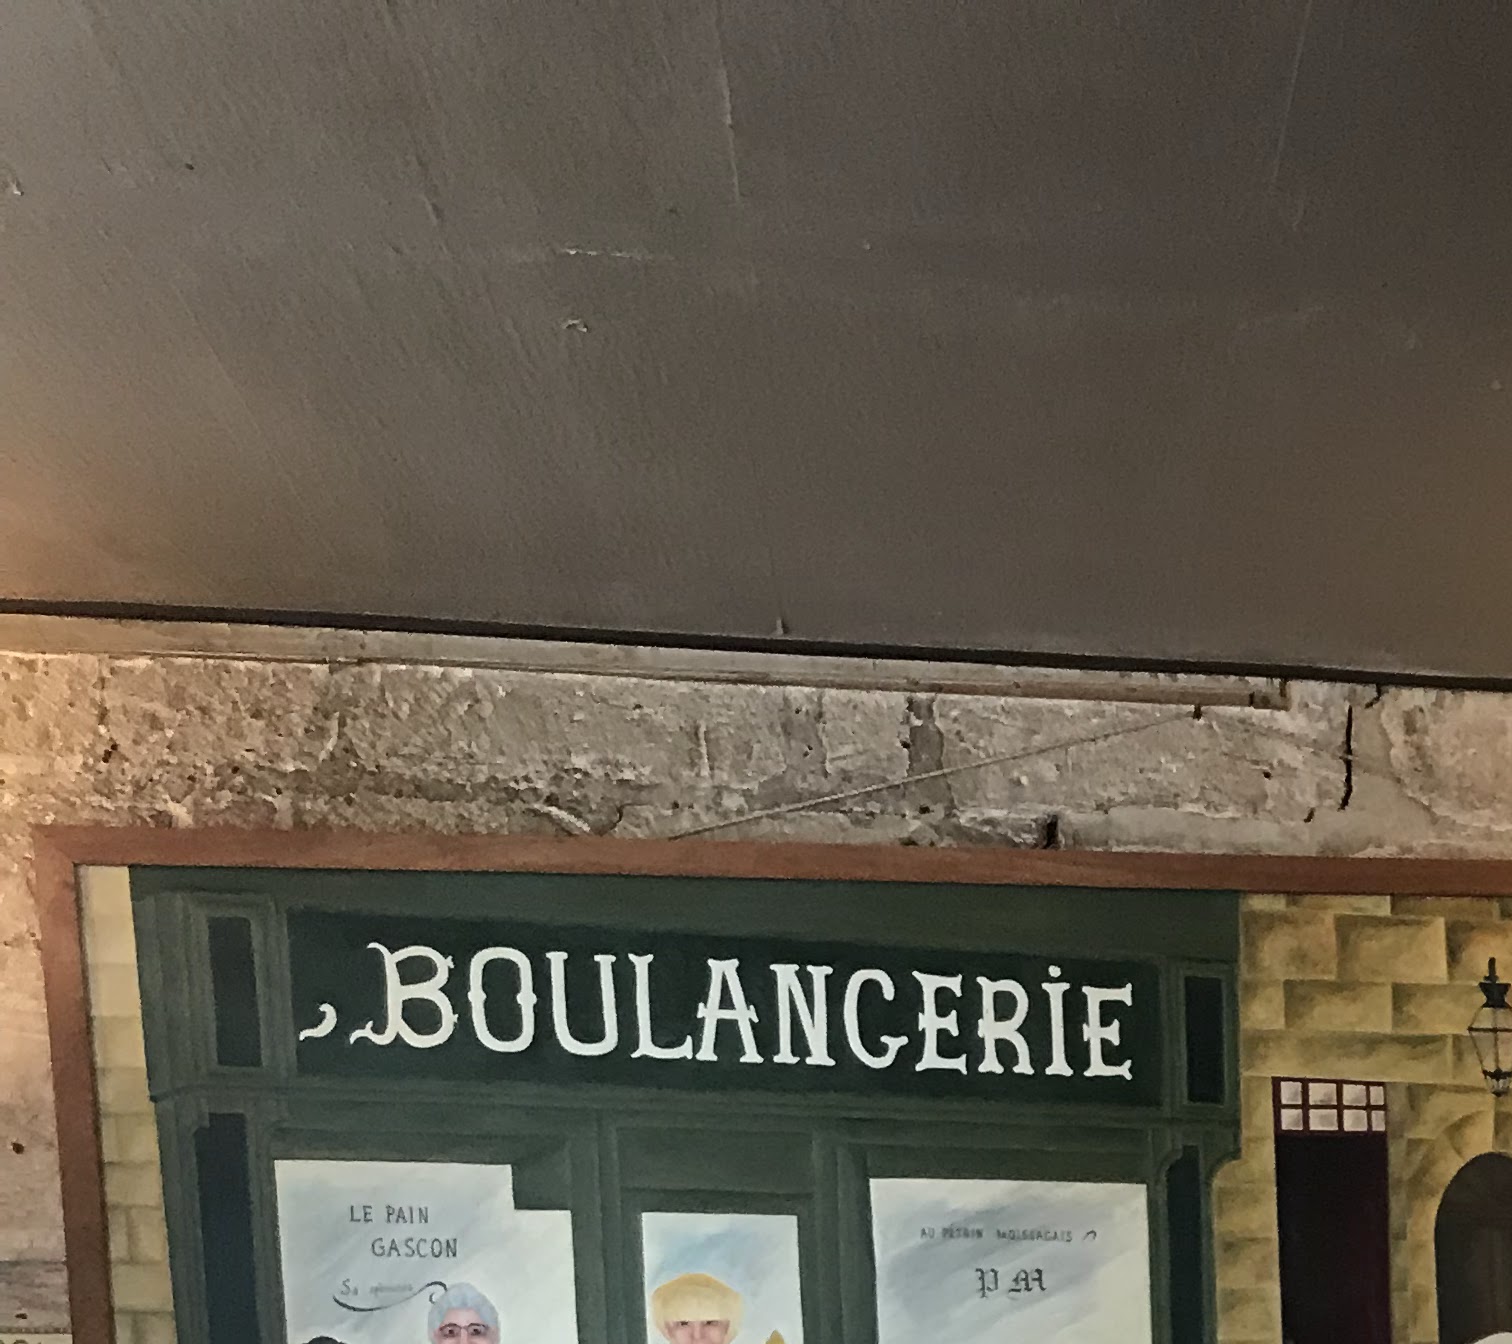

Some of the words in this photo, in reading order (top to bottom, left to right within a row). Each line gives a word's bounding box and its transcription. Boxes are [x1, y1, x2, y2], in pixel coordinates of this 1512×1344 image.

[350, 942, 1133, 1081] BOULANGERIE
[349, 1205, 373, 1223] LE
[386, 1204, 429, 1224] PAIN
[371, 1237, 458, 1258] GASCON
